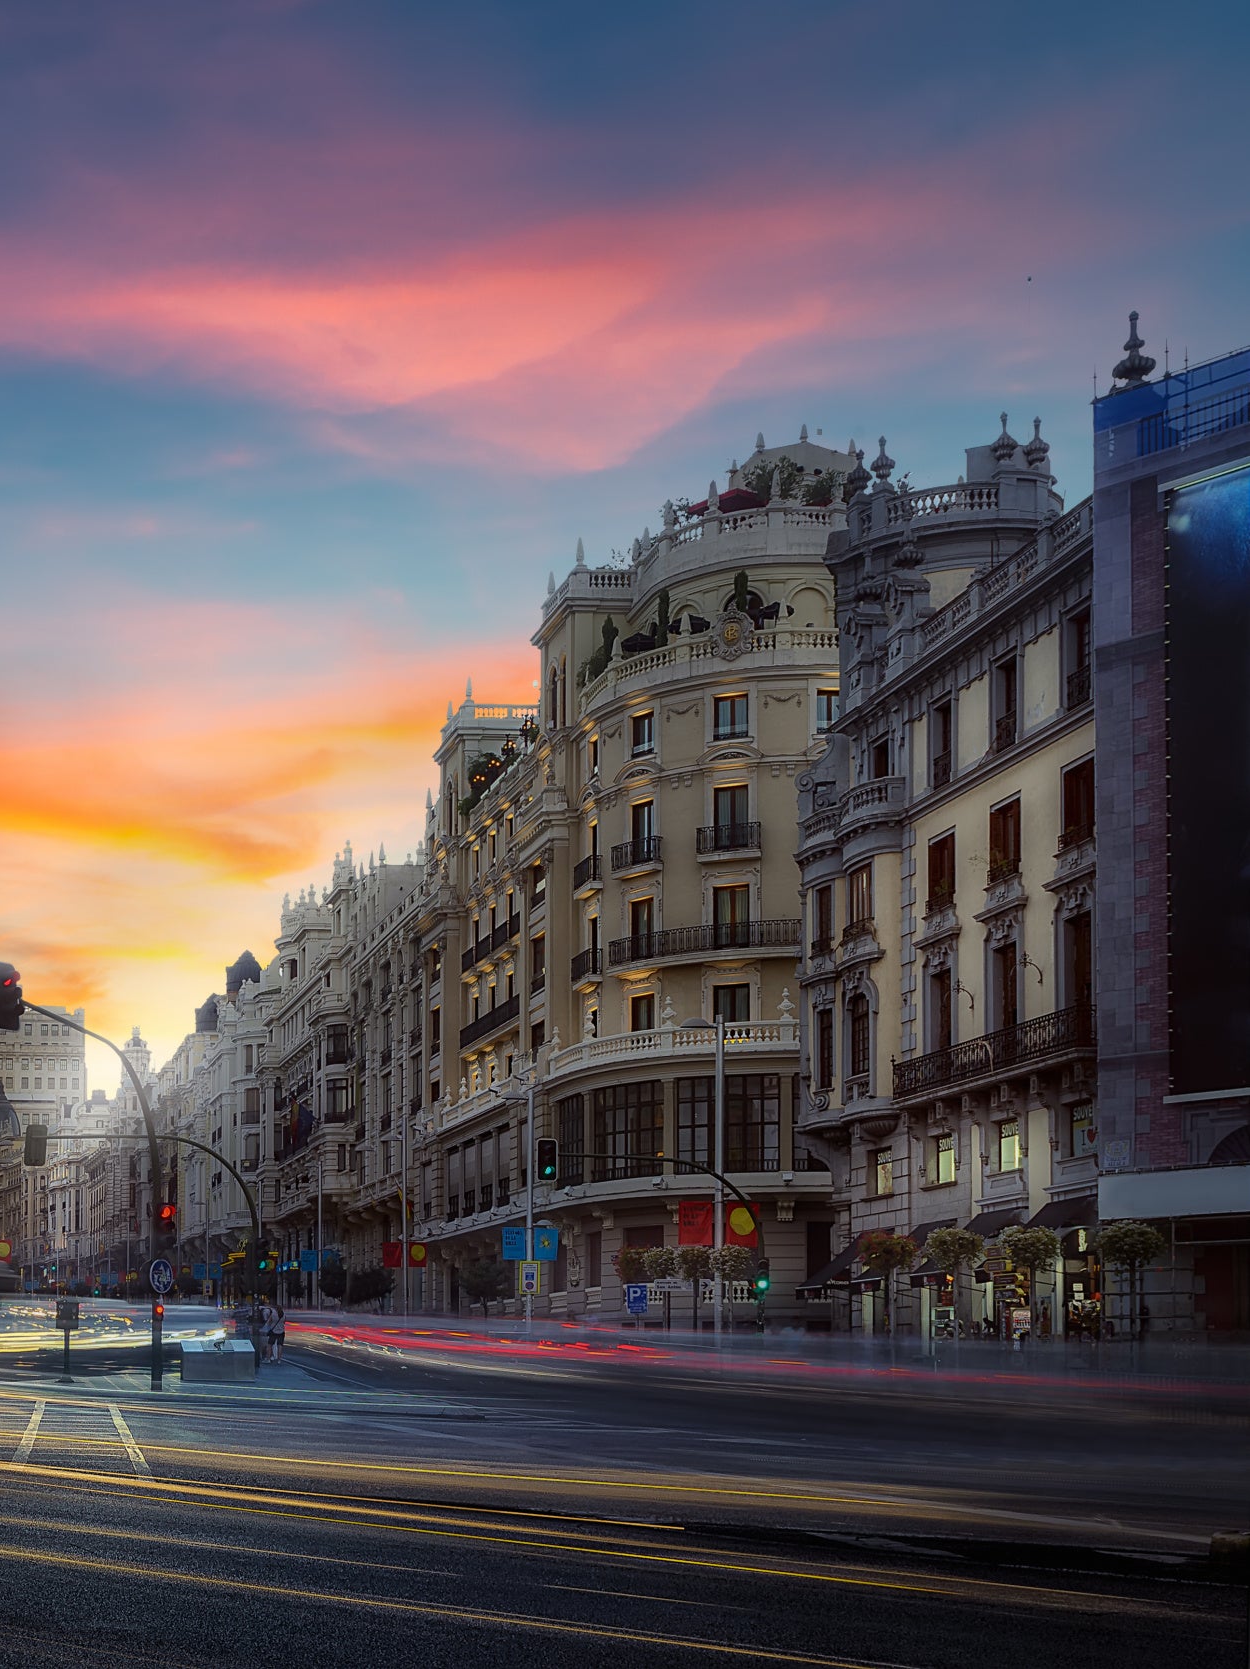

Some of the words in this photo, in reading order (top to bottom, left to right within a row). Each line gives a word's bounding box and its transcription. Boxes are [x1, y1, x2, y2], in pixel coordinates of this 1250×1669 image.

[1073, 1104, 1093, 1120] SOUVE
[1002, 1123, 1019, 1137] SOUVE
[1081, 1129, 1087, 1145] I
[630, 1287, 641, 1302] P
